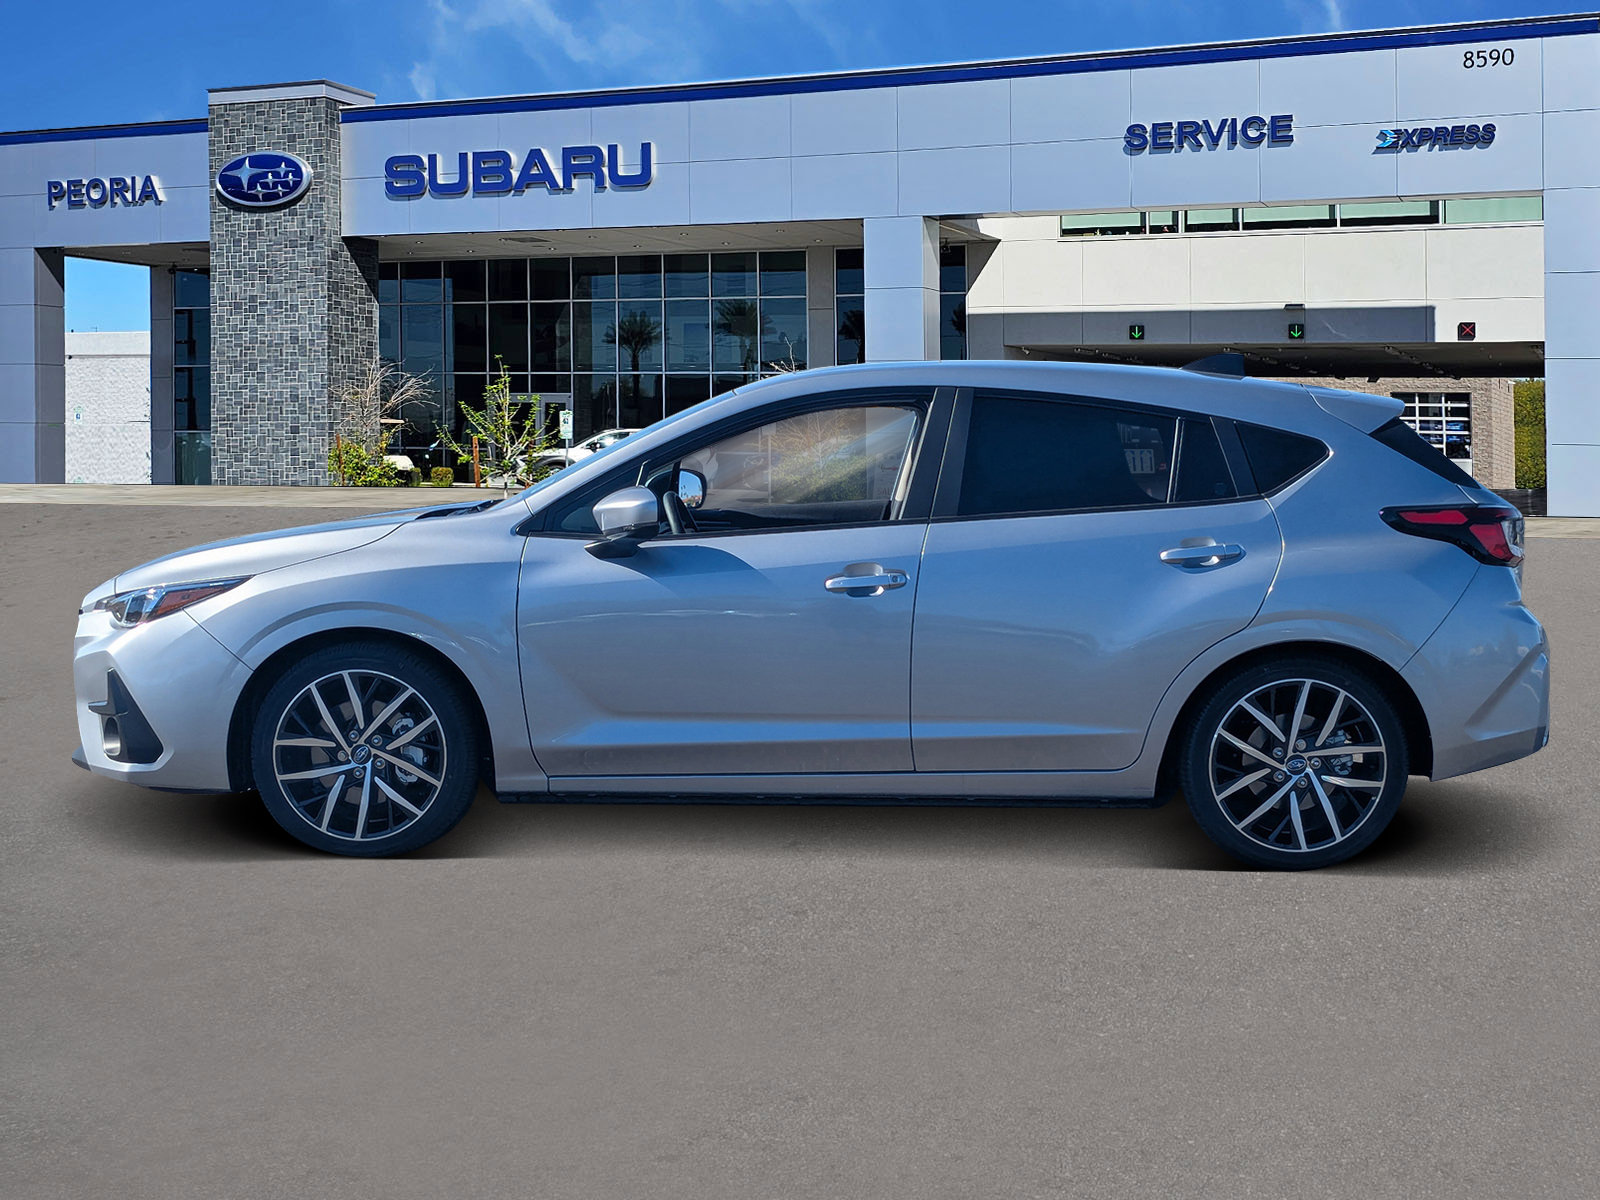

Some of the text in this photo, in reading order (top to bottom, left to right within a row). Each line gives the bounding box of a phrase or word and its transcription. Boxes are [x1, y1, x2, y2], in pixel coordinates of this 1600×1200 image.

[1463, 48, 1514, 69] 8590
[1125, 115, 1294, 151] SERVICE
[1375, 123, 1497, 150] EXPRESS
[384, 142, 653, 197] SUBARU
[47, 175, 161, 208] PEORIA
